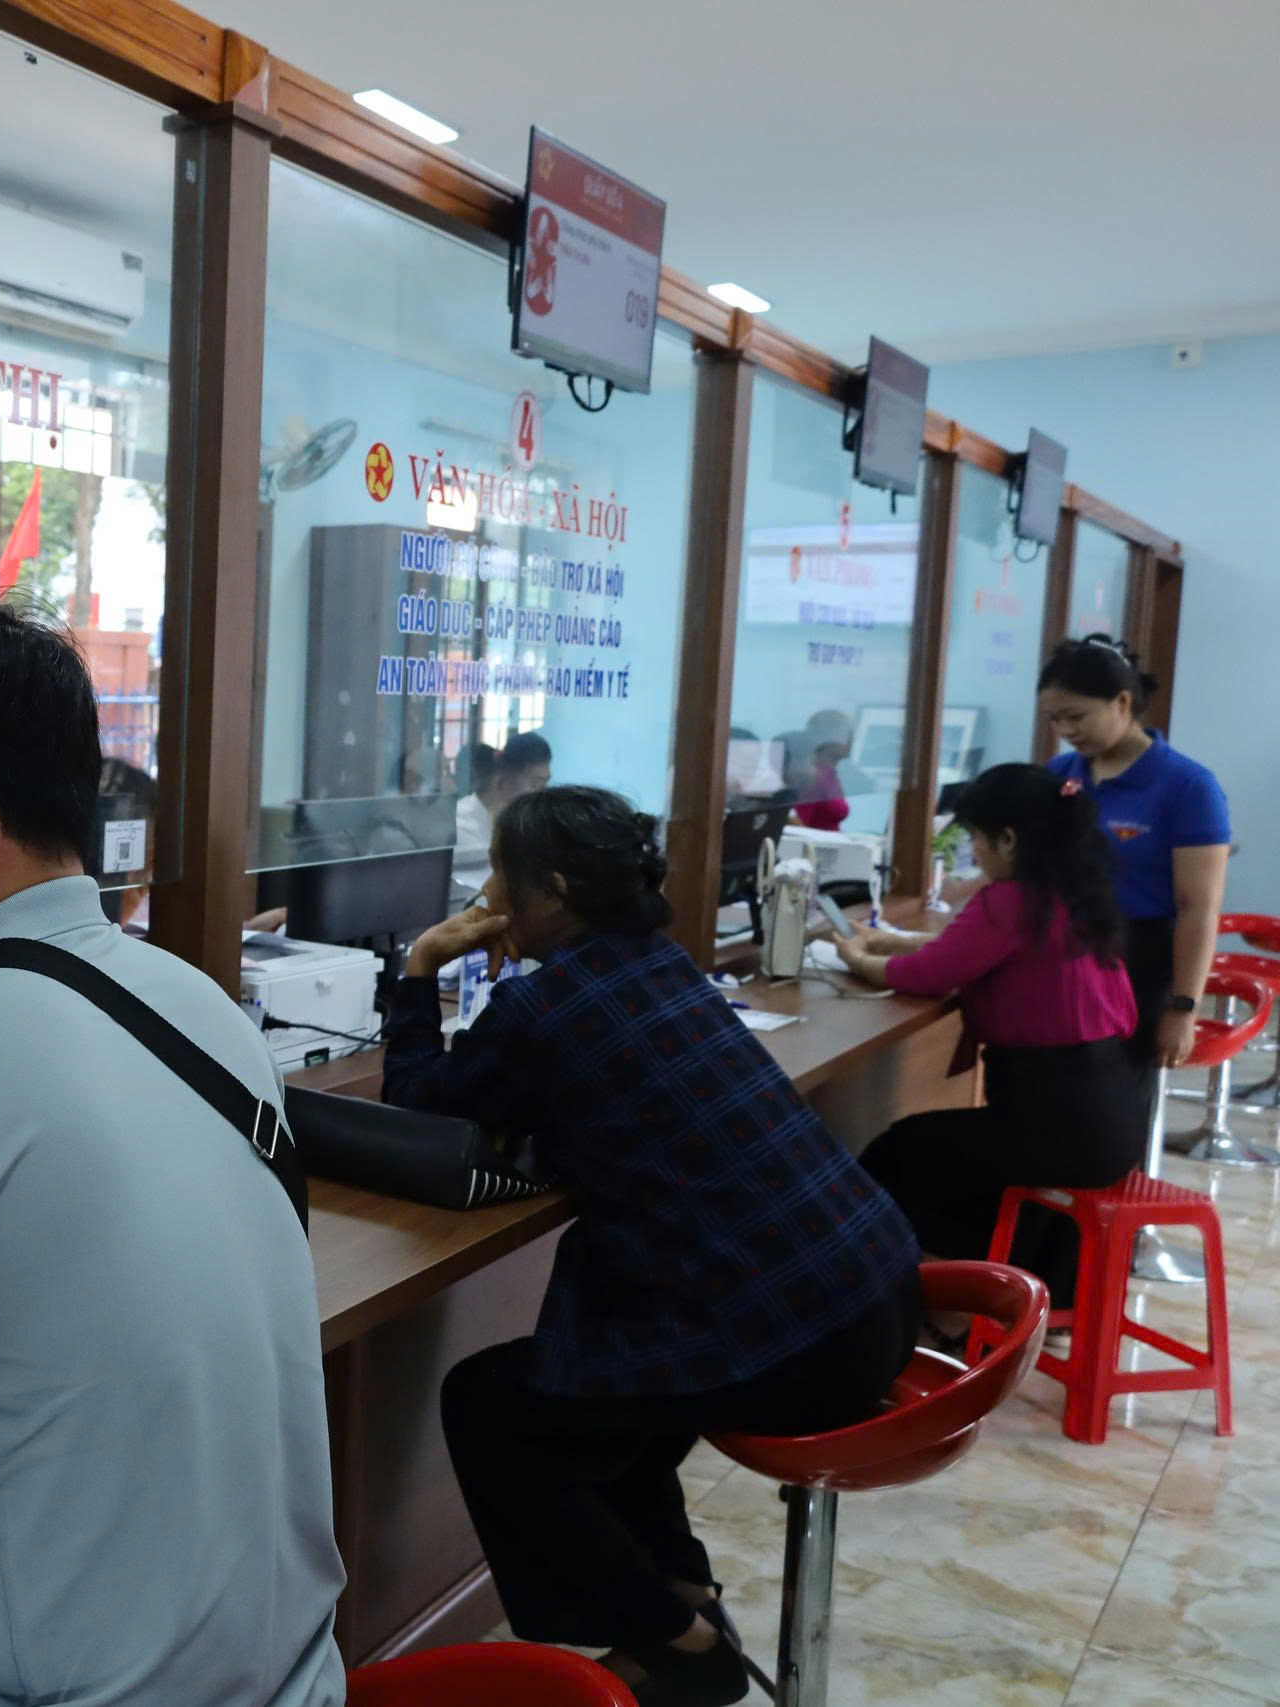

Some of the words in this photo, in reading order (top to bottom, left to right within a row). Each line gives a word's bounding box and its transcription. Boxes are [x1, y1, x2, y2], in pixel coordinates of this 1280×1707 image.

[517, 399, 534, 461] 4
[408, 449, 470, 507] VĂN
[549, 484, 582, 534] XÃ
[587, 492, 628, 551] HỘI
[561, 560, 585, 600] TRỢ
[605, 563, 625, 604] HỘI
[398, 588, 438, 636] GIÁO
[440, 599, 474, 643] DỤC
[376, 655, 404, 695] AN
[607, 670, 614, 698] Y
[617, 660, 631, 699] TẾ
